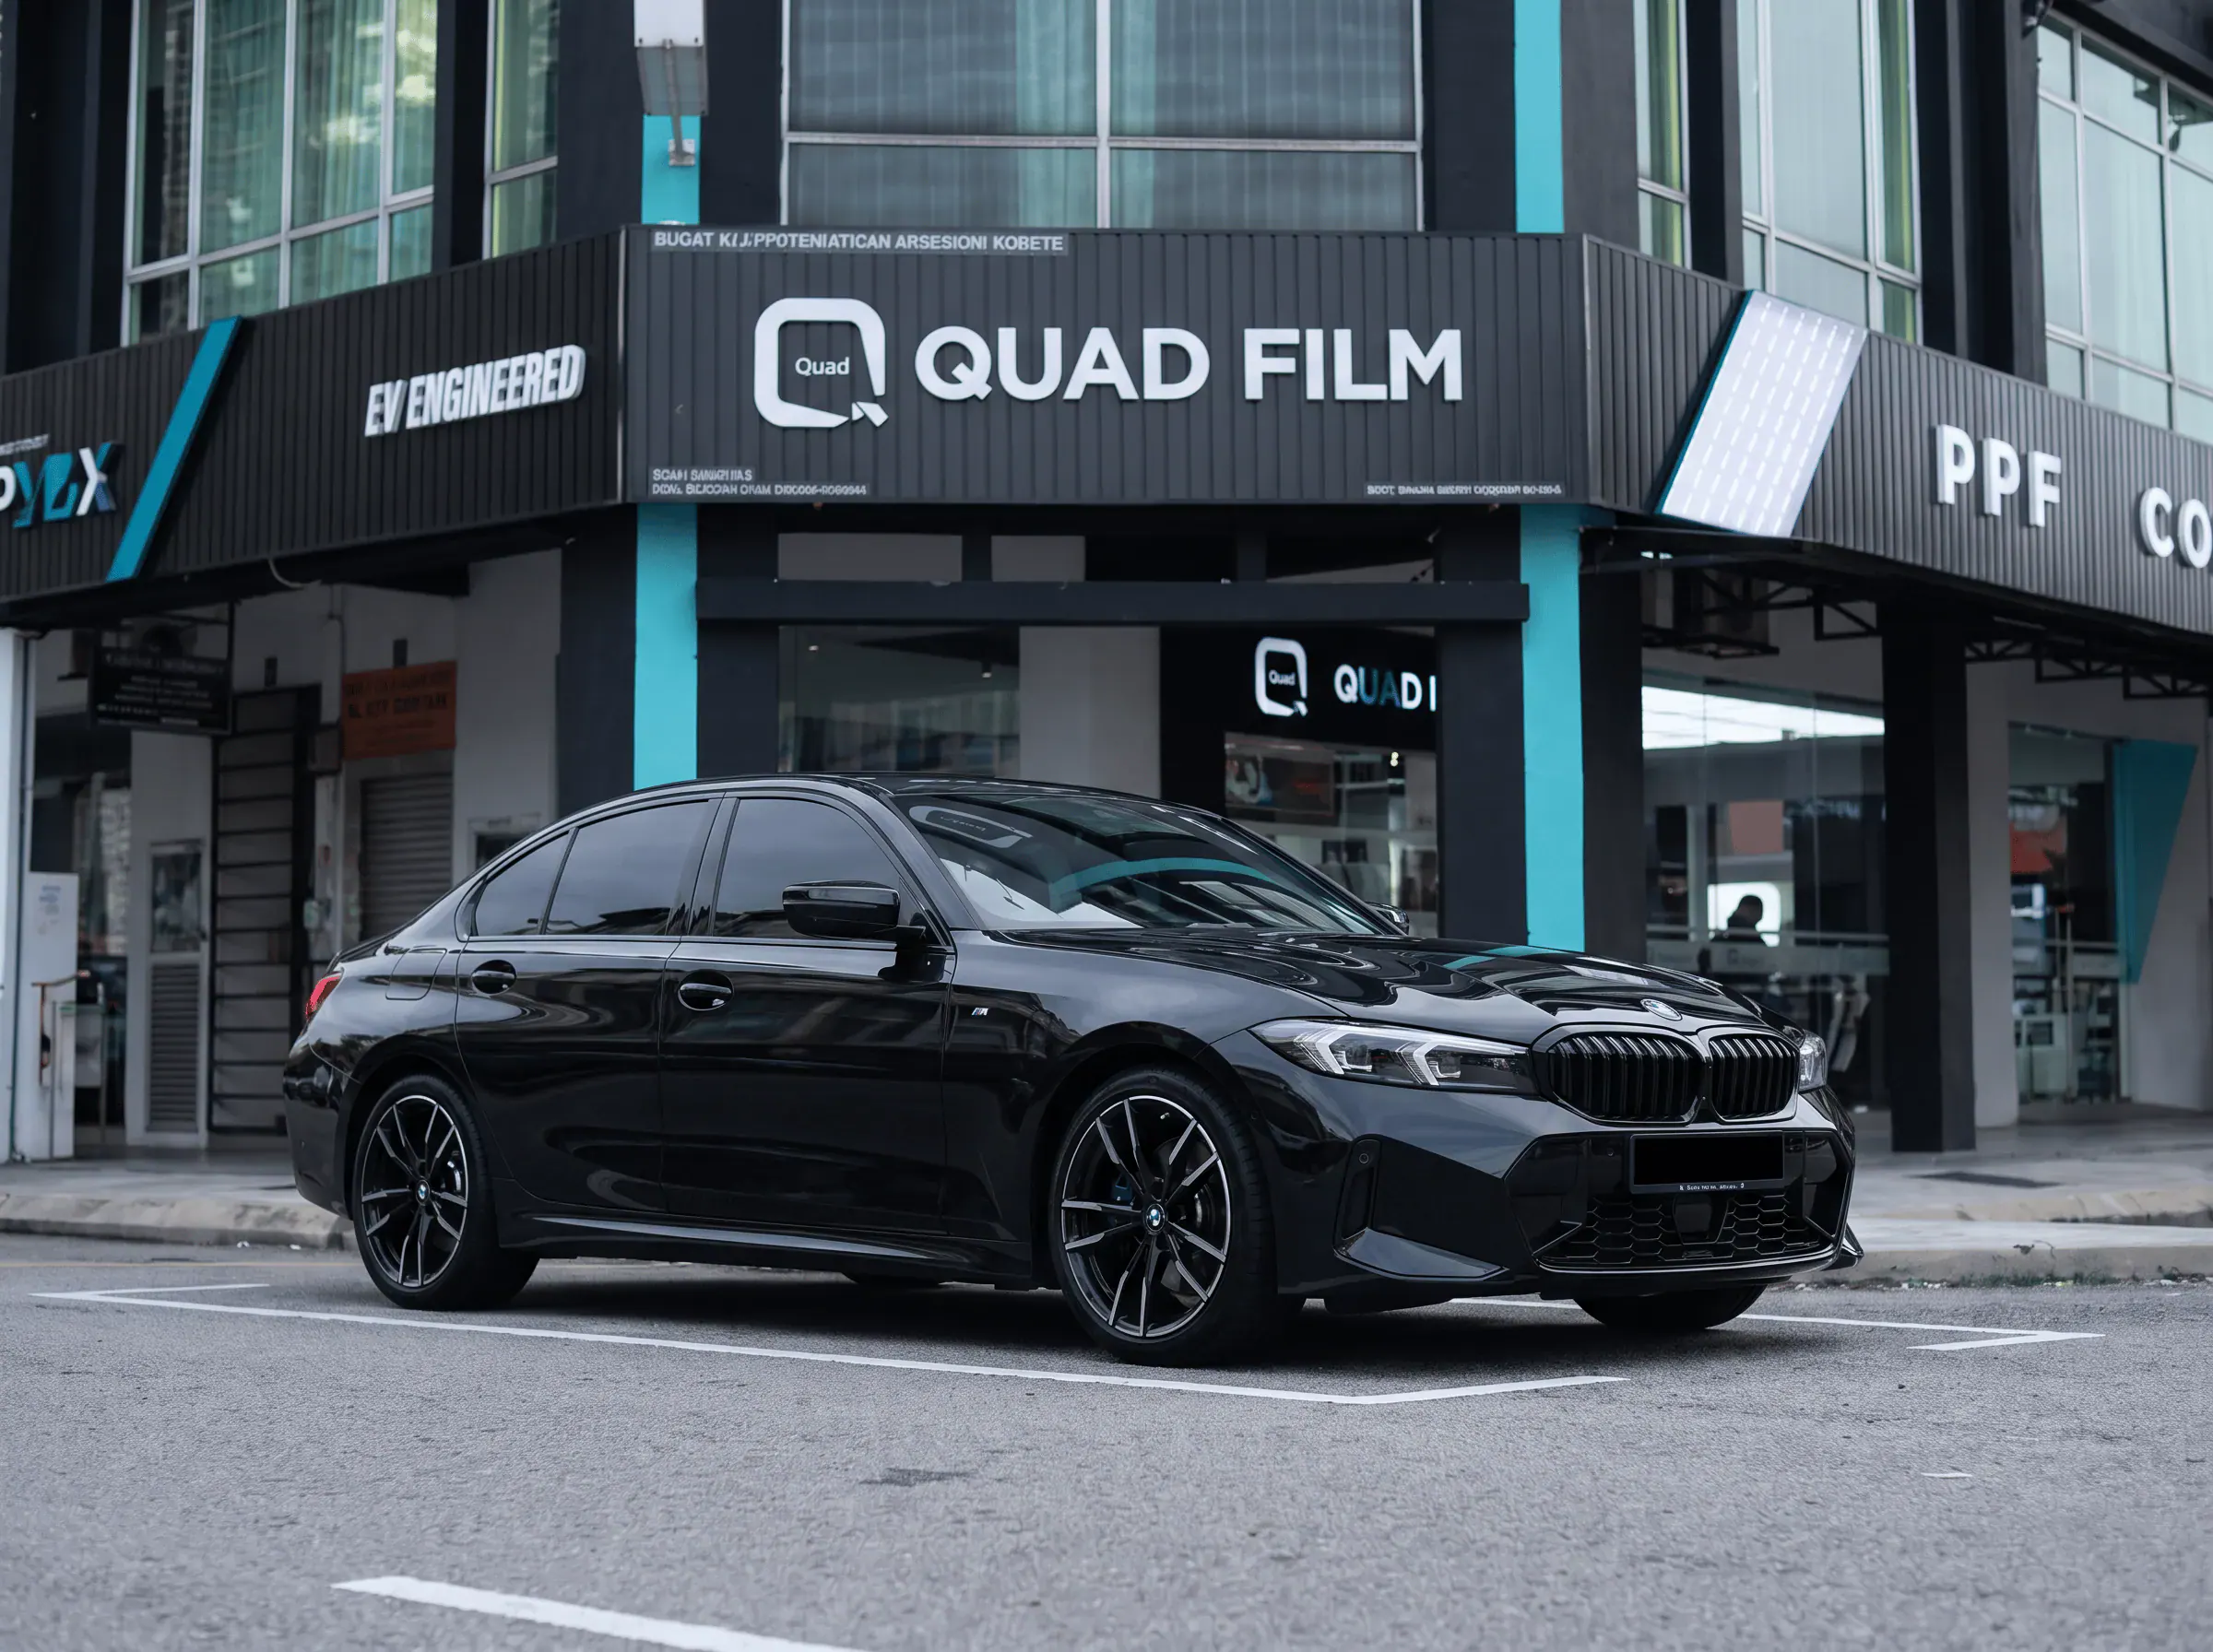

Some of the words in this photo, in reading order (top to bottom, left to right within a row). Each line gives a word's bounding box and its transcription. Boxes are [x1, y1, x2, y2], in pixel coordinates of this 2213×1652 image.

[654, 231, 715, 247] BUGAT
[993, 235, 1064, 252] KOBETE
[364, 379, 408, 437] EV
[406, 344, 586, 430] ENGINEERED
[795, 357, 850, 377] Quad
[915, 325, 1210, 400] QUAD
[1244, 328, 1462, 400] FILM
[1935, 424, 2062, 527] PPF
[2139, 487, 2213, 569] CO
[1268, 669, 1296, 686] Quad
[1334, 664, 1423, 709] QUAD
